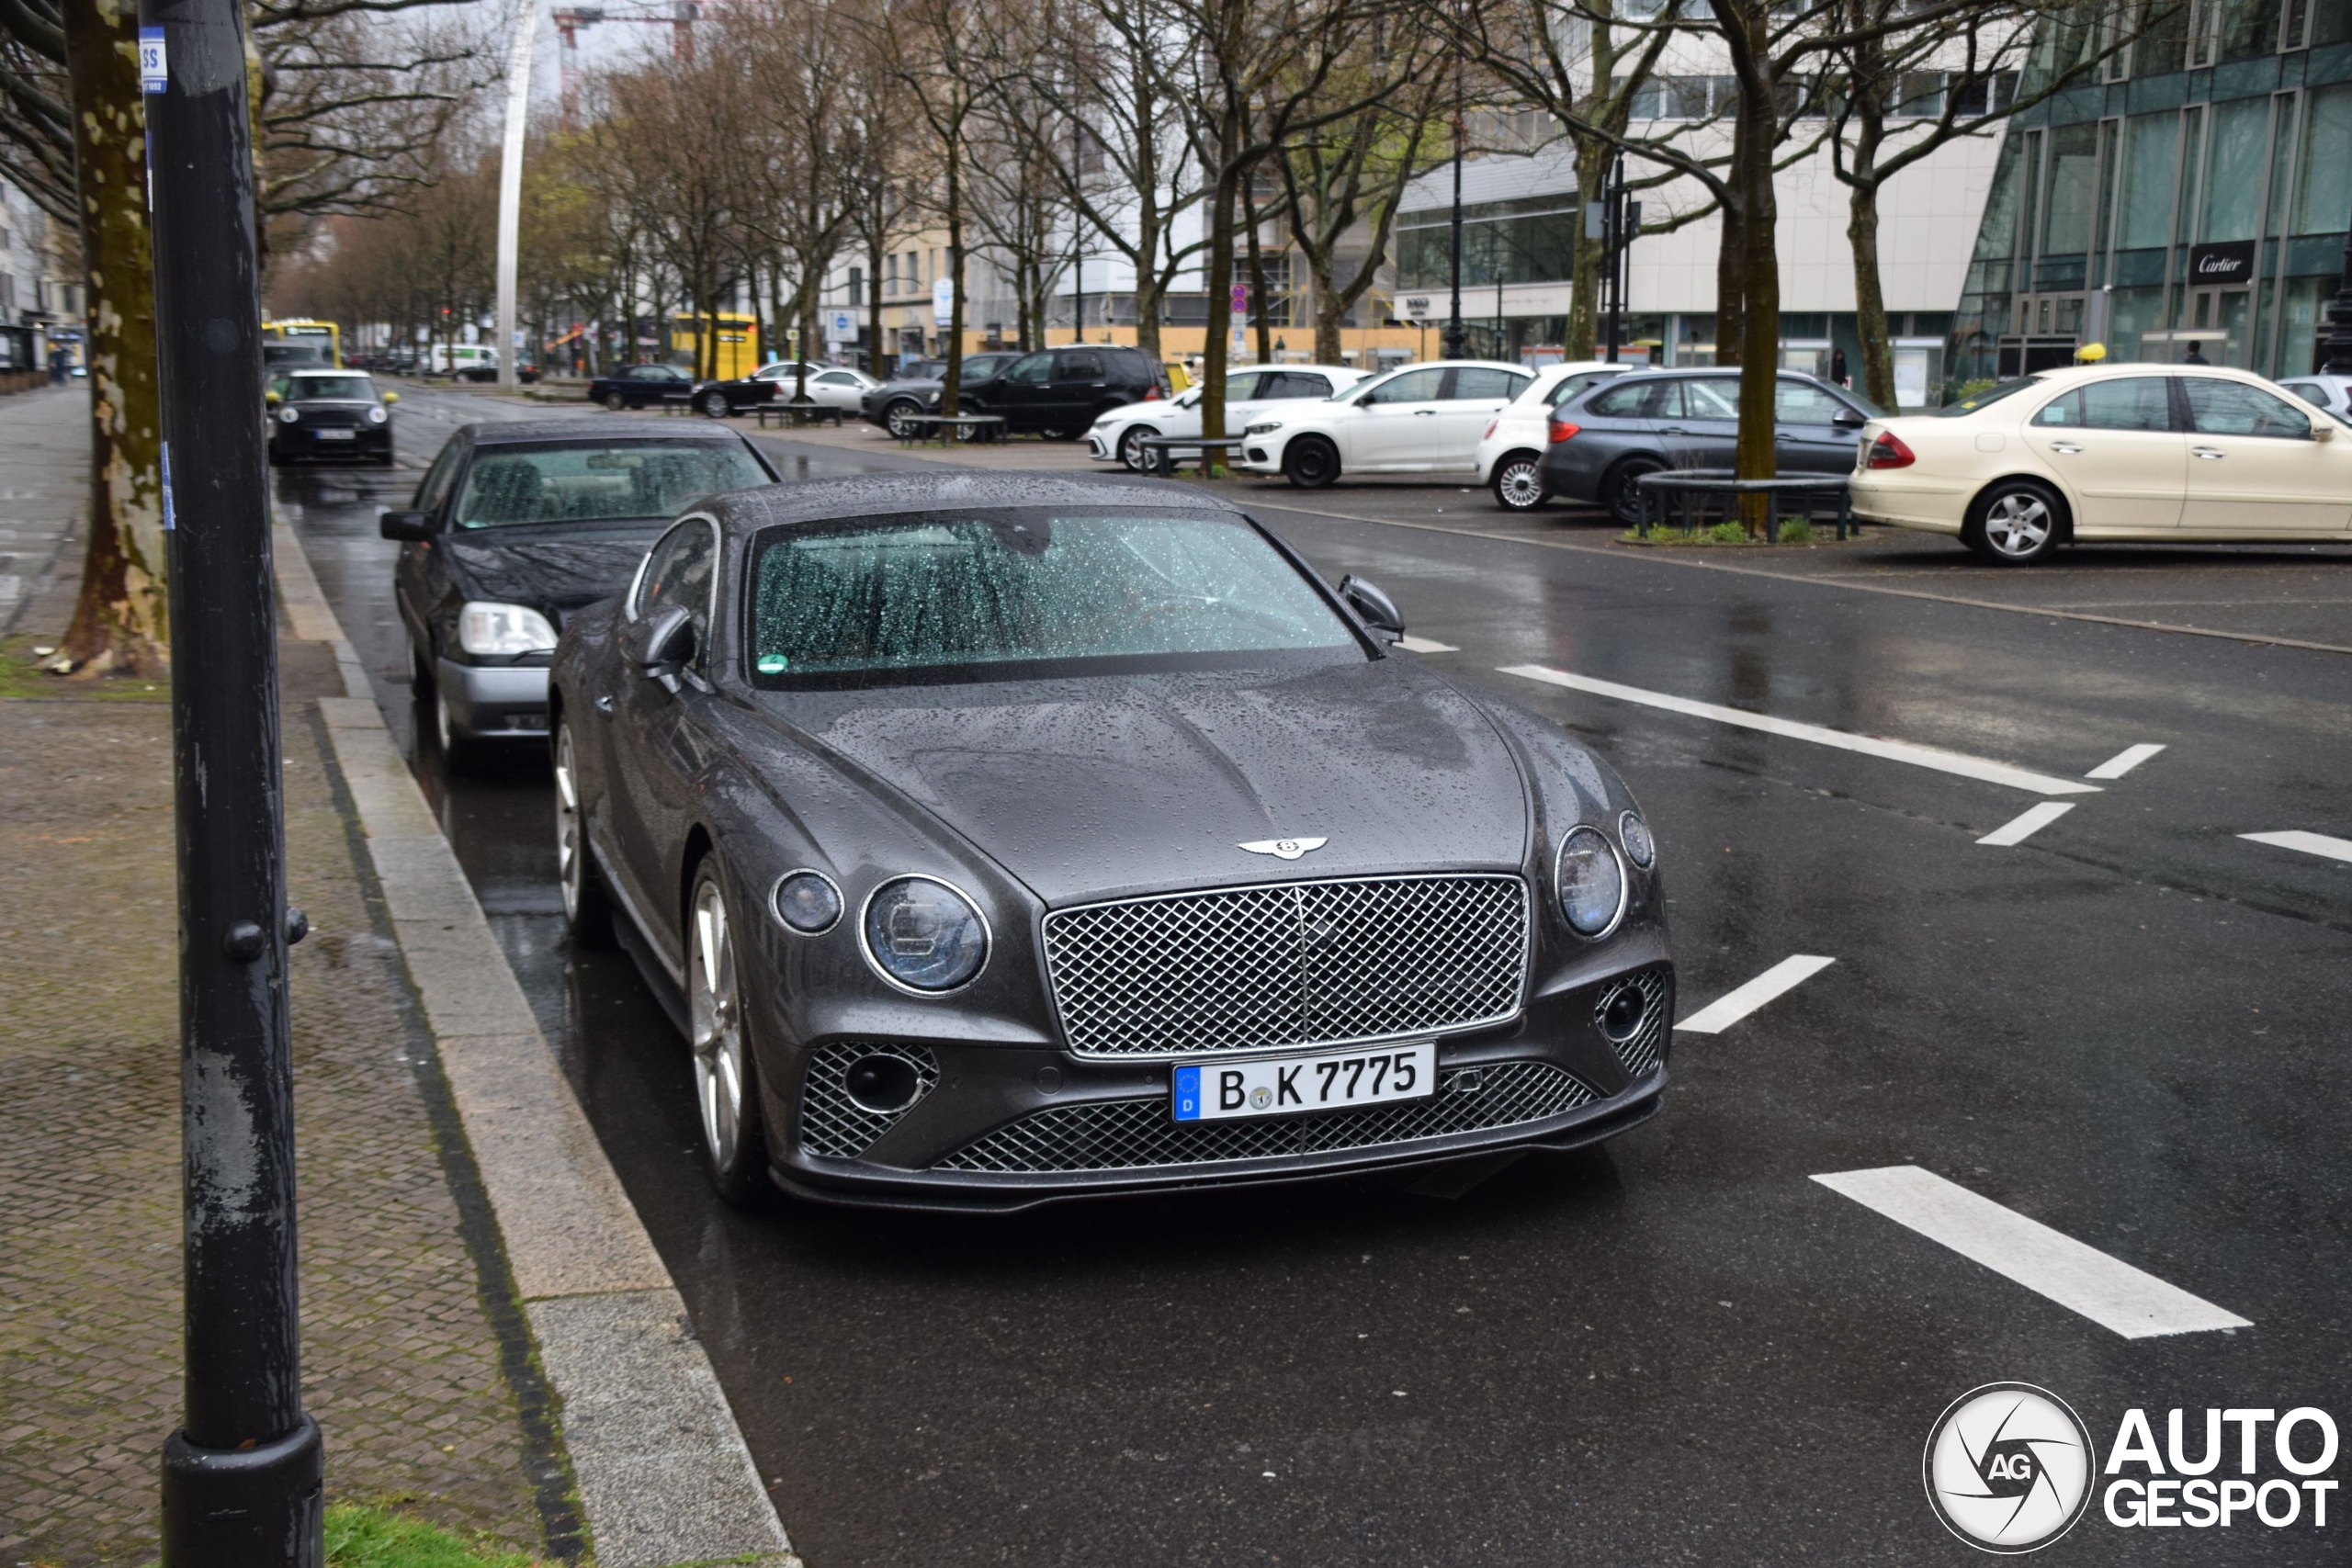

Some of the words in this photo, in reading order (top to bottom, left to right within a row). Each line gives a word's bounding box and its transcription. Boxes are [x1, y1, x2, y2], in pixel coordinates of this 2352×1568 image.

[2199, 254, 2242, 273] Cartier
[1219, 1070, 1246, 1111] B
[1278, 1065, 1303, 1106] K
[1317, 1052, 1417, 1101] 7775
[1182, 1100, 1193, 1111] D
